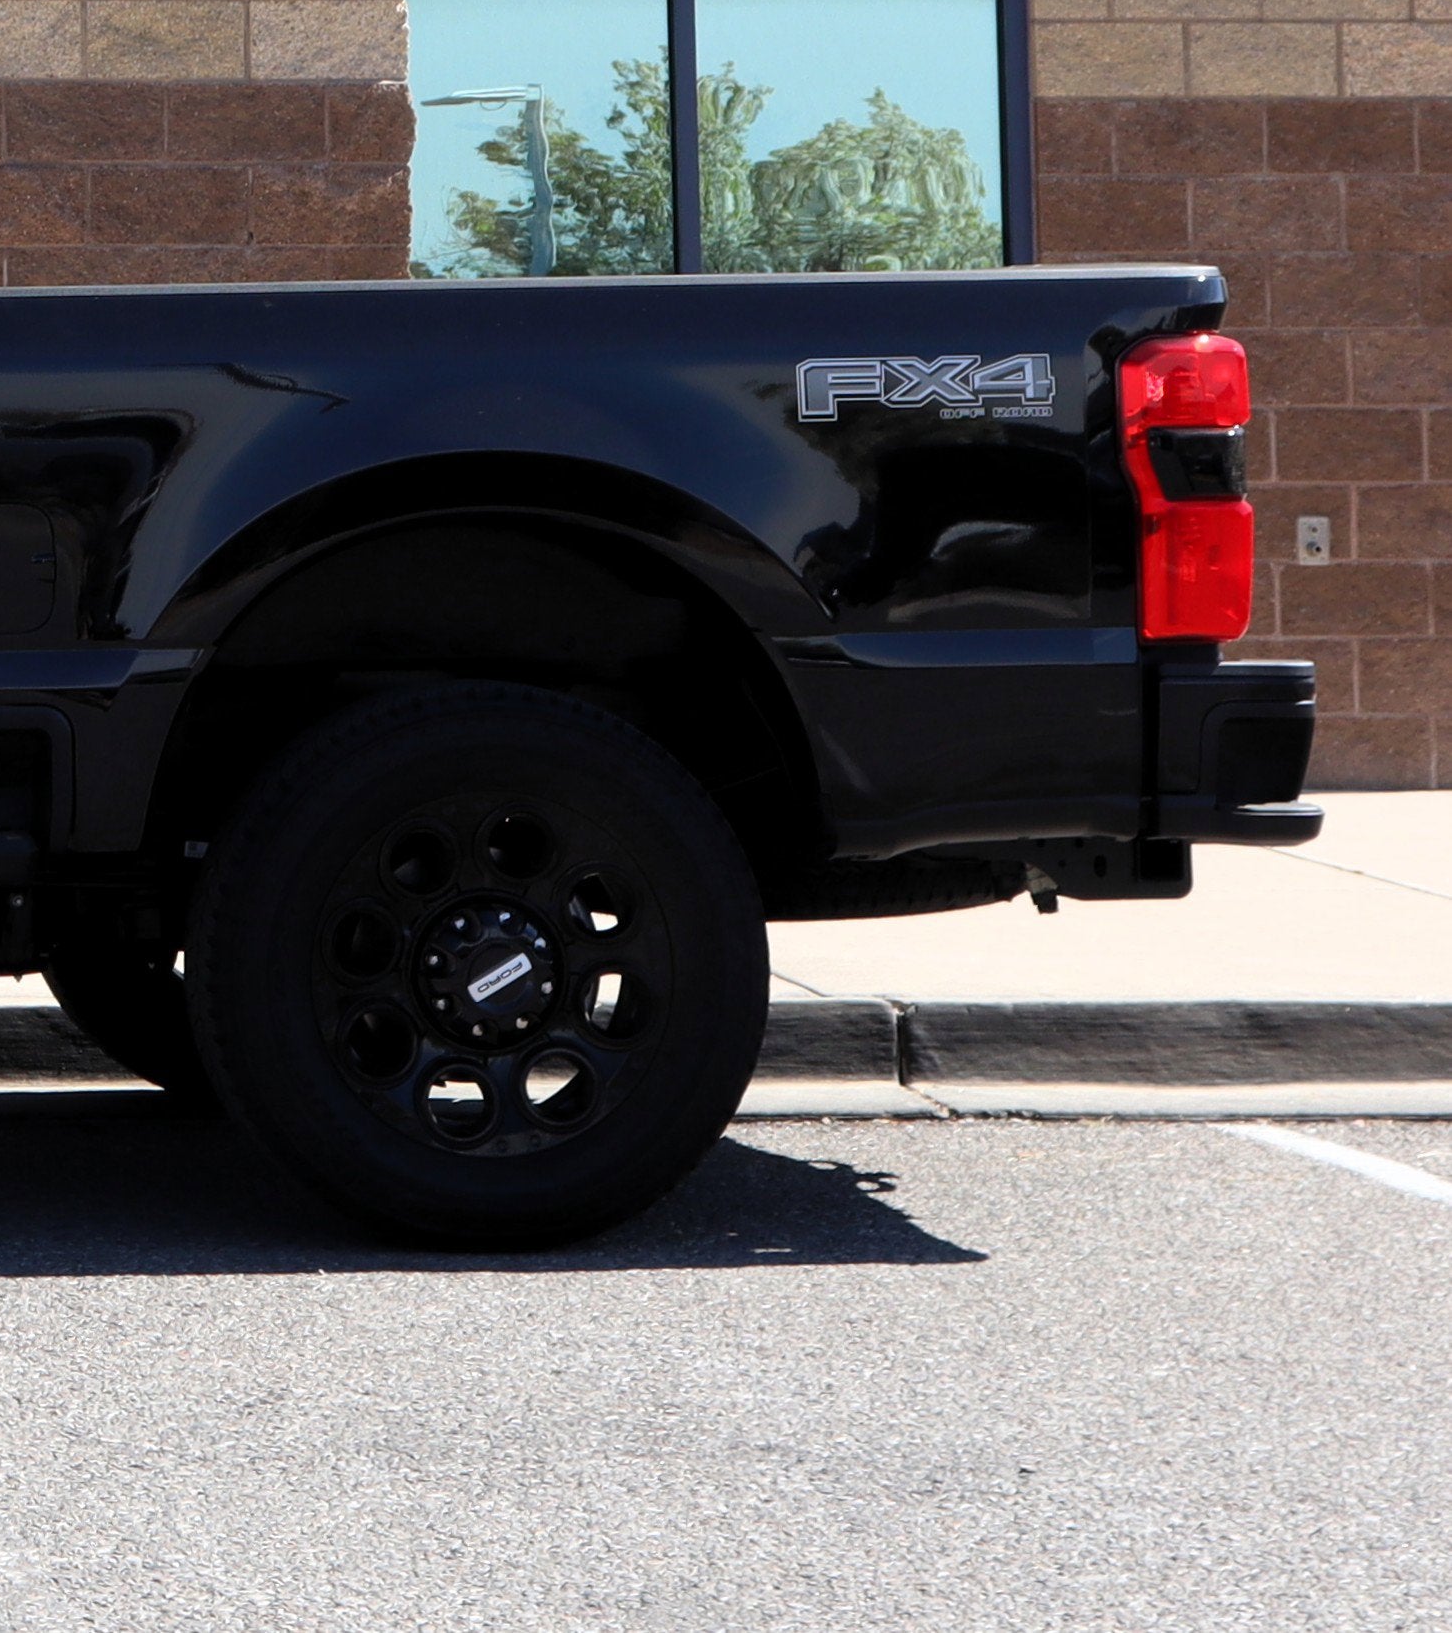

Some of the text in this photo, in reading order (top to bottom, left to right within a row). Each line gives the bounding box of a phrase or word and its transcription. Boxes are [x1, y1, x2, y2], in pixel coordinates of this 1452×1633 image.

[796, 353, 1056, 423] FX4
[939, 407, 986, 419] OFF
[477, 960, 524, 994] FORD
